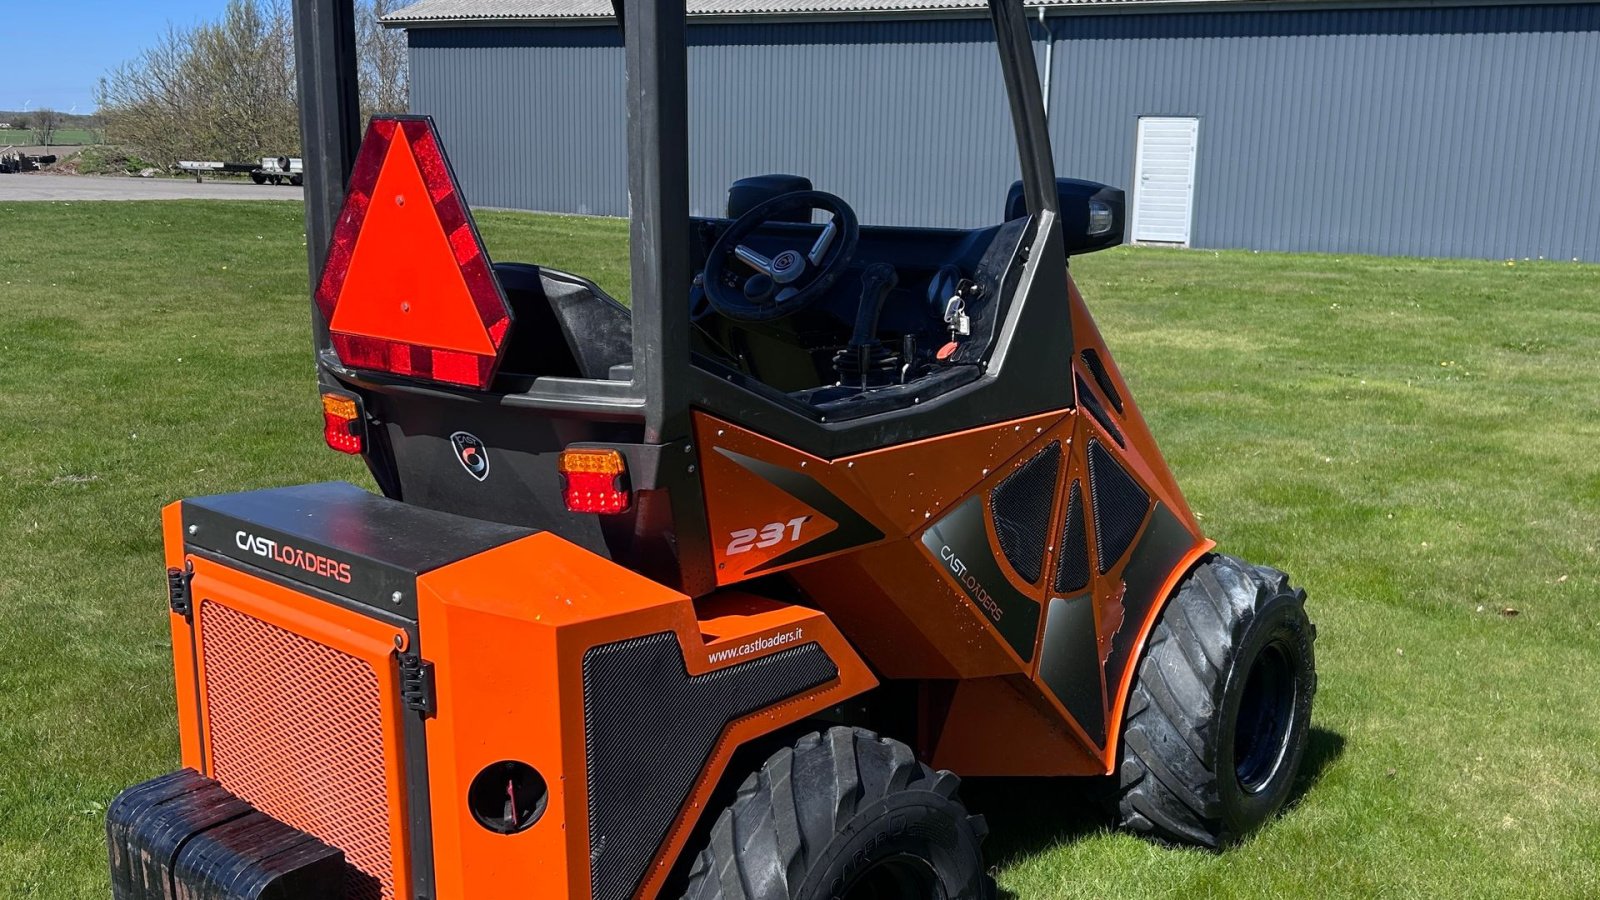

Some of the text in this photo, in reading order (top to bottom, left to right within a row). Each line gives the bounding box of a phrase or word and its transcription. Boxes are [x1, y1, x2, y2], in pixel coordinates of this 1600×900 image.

[235, 530, 351, 584] CASTLOADERS
[726, 516, 808, 556] 23T
[940, 545, 1003, 621] CASTLOADERS
[708, 627, 803, 664] www.castloaders.it
